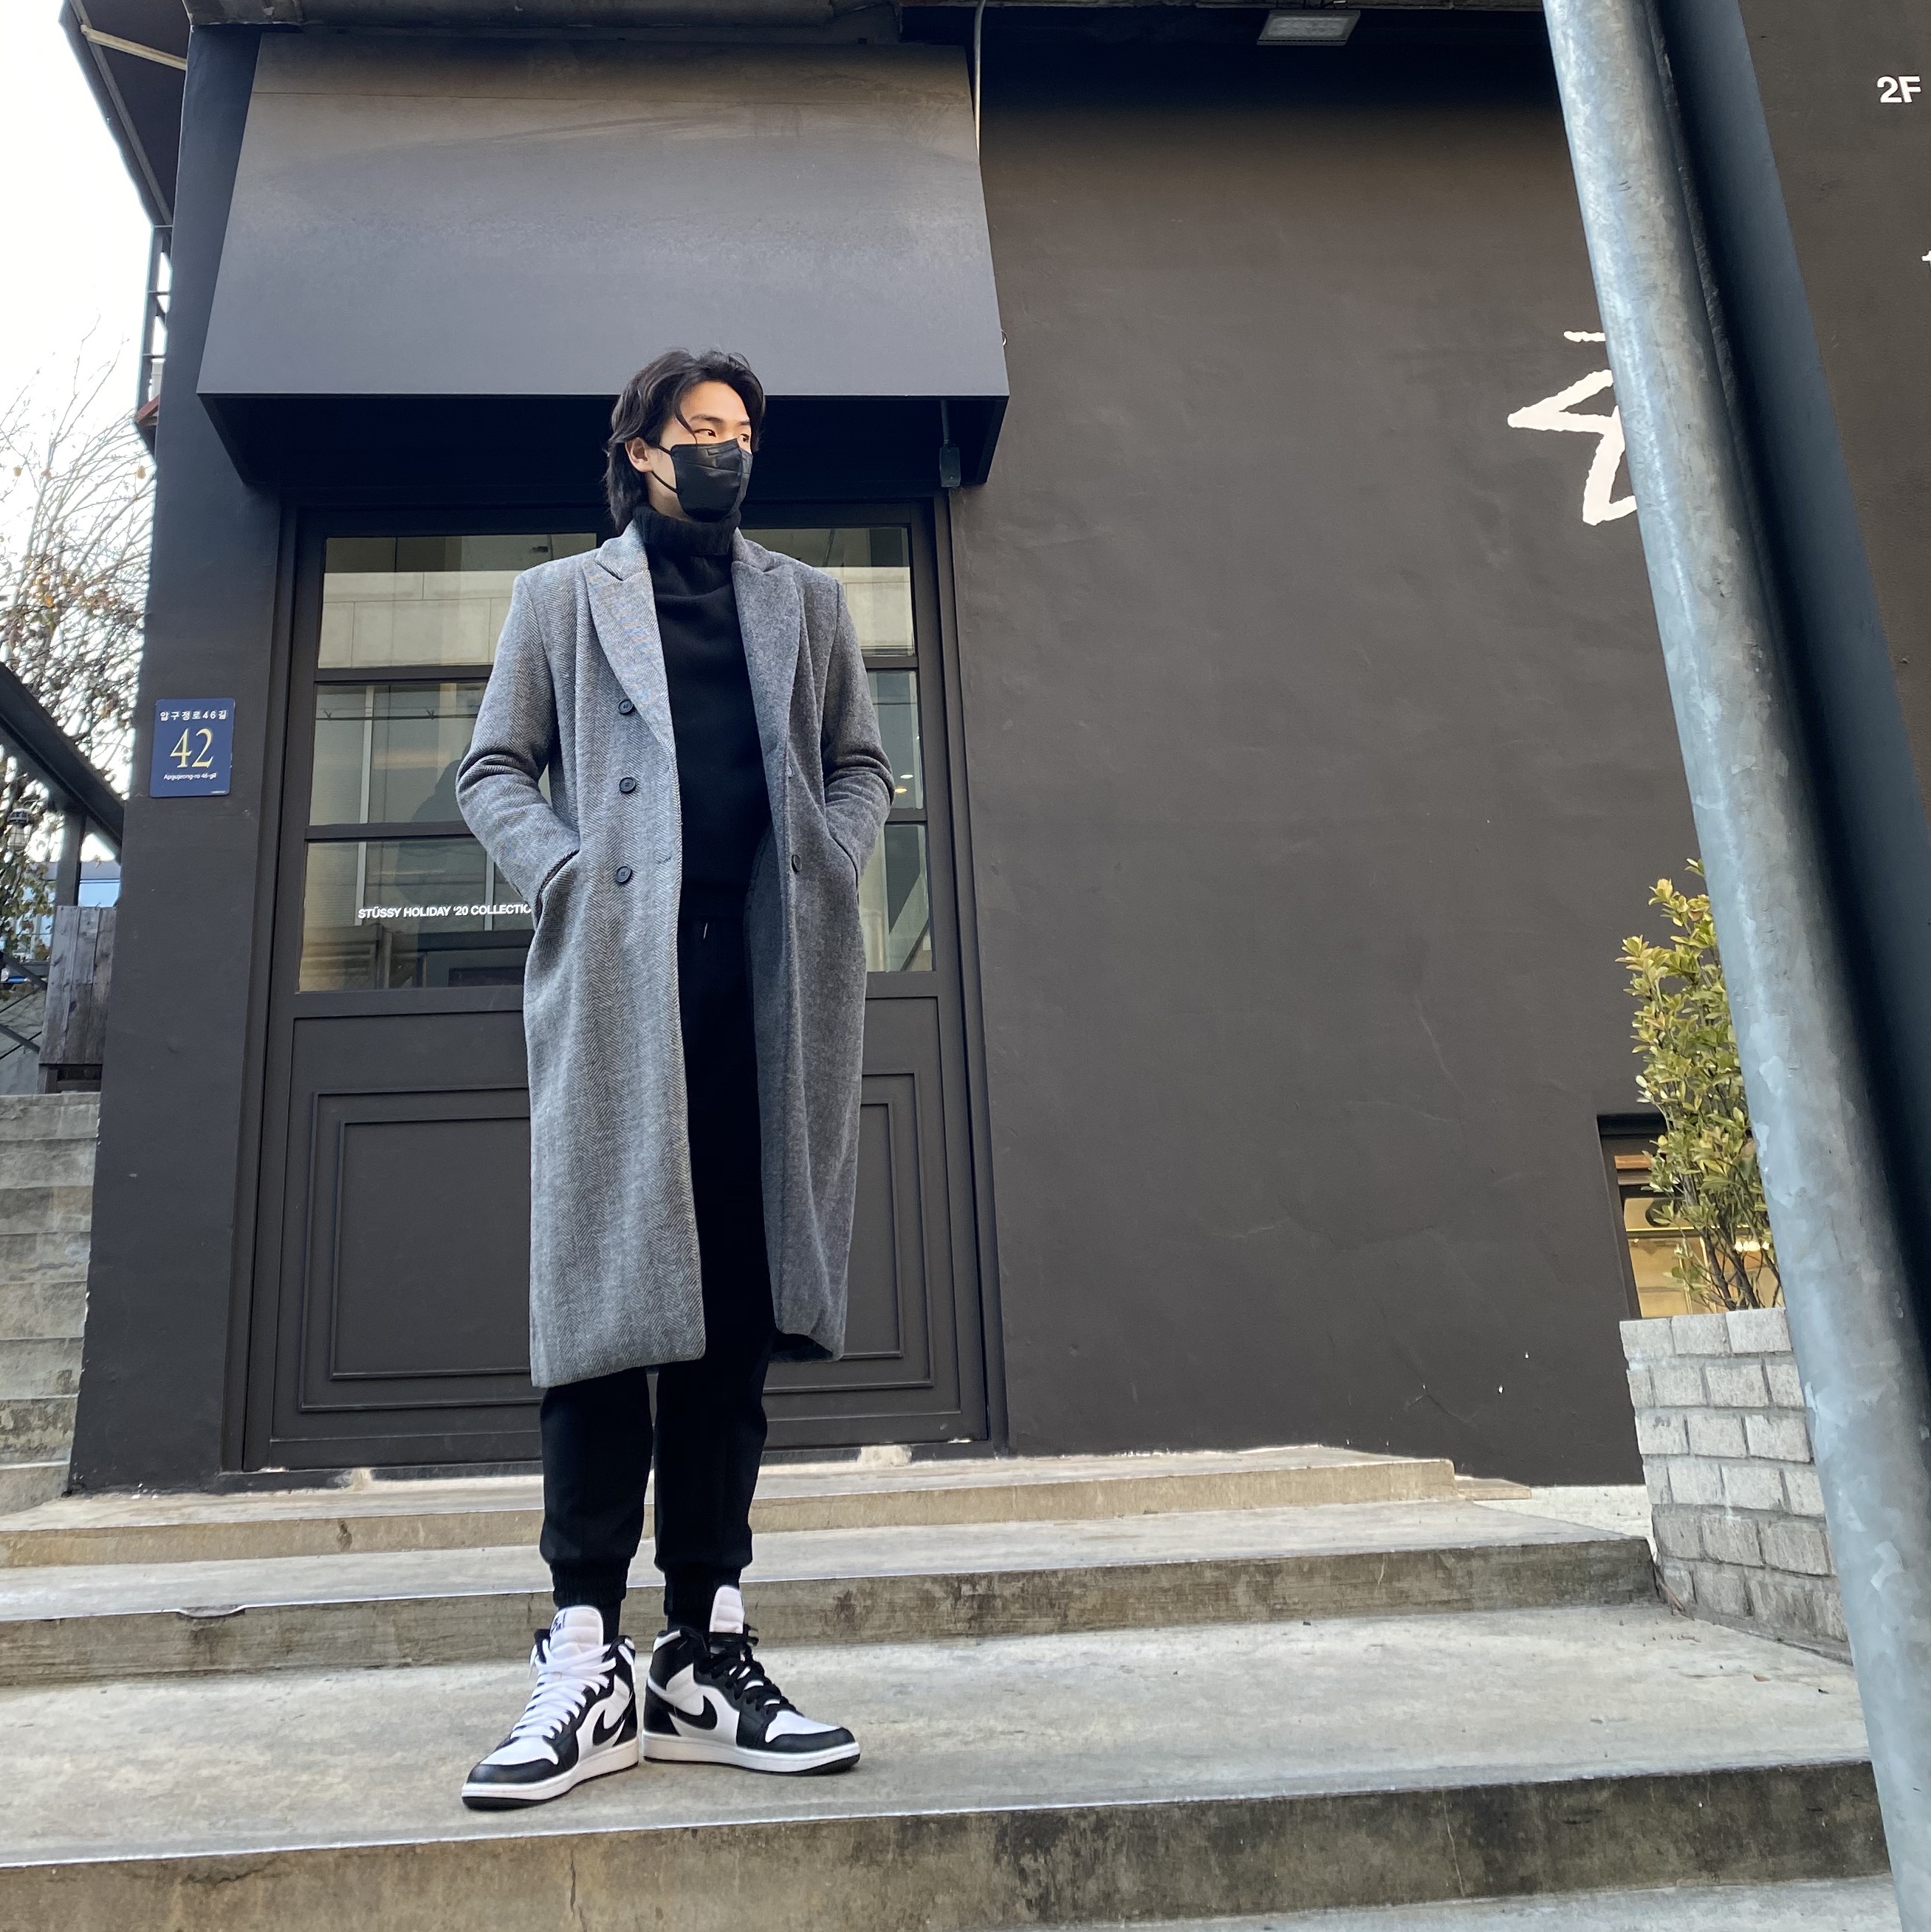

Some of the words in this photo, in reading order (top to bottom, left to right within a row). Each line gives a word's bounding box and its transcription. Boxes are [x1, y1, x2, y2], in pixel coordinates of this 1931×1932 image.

[1876, 75, 1921, 103] 2F
[160, 710, 227, 721] 압구정로46길
[170, 727, 214, 768] 42
[357, 906, 402, 919] STÜSSY
[403, 905, 451, 917] HOLIDAY
